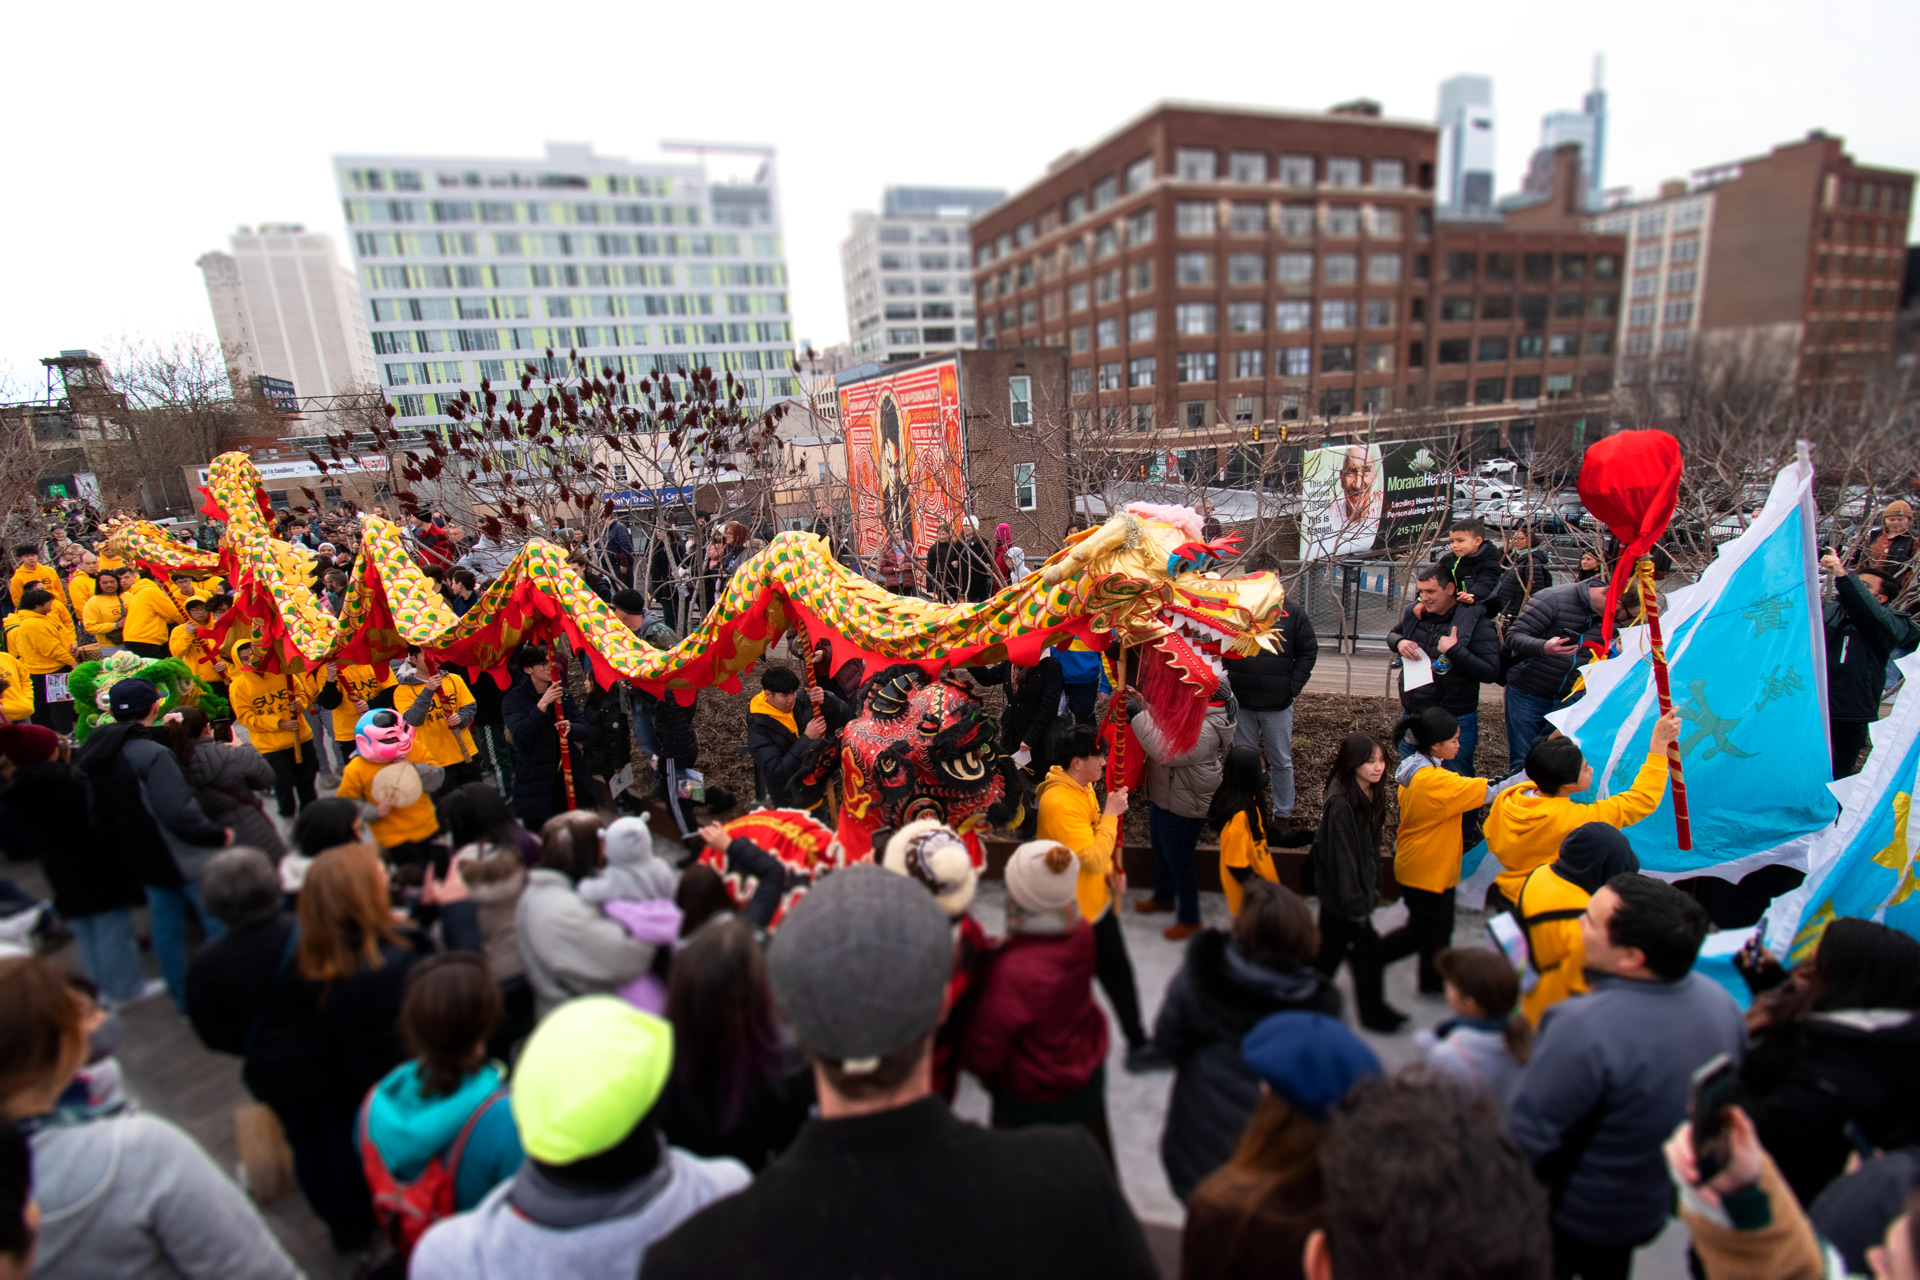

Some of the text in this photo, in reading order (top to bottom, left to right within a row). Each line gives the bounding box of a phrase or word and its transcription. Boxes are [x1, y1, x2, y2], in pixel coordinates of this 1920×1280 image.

[1391, 499, 1416, 508] Leading
[1308, 513, 1330, 524] Tis is
[1387, 504, 1450, 519] Personalizing Sevic.
[252, 688, 289, 709] SUNS
[428, 693, 457, 712] SUS
